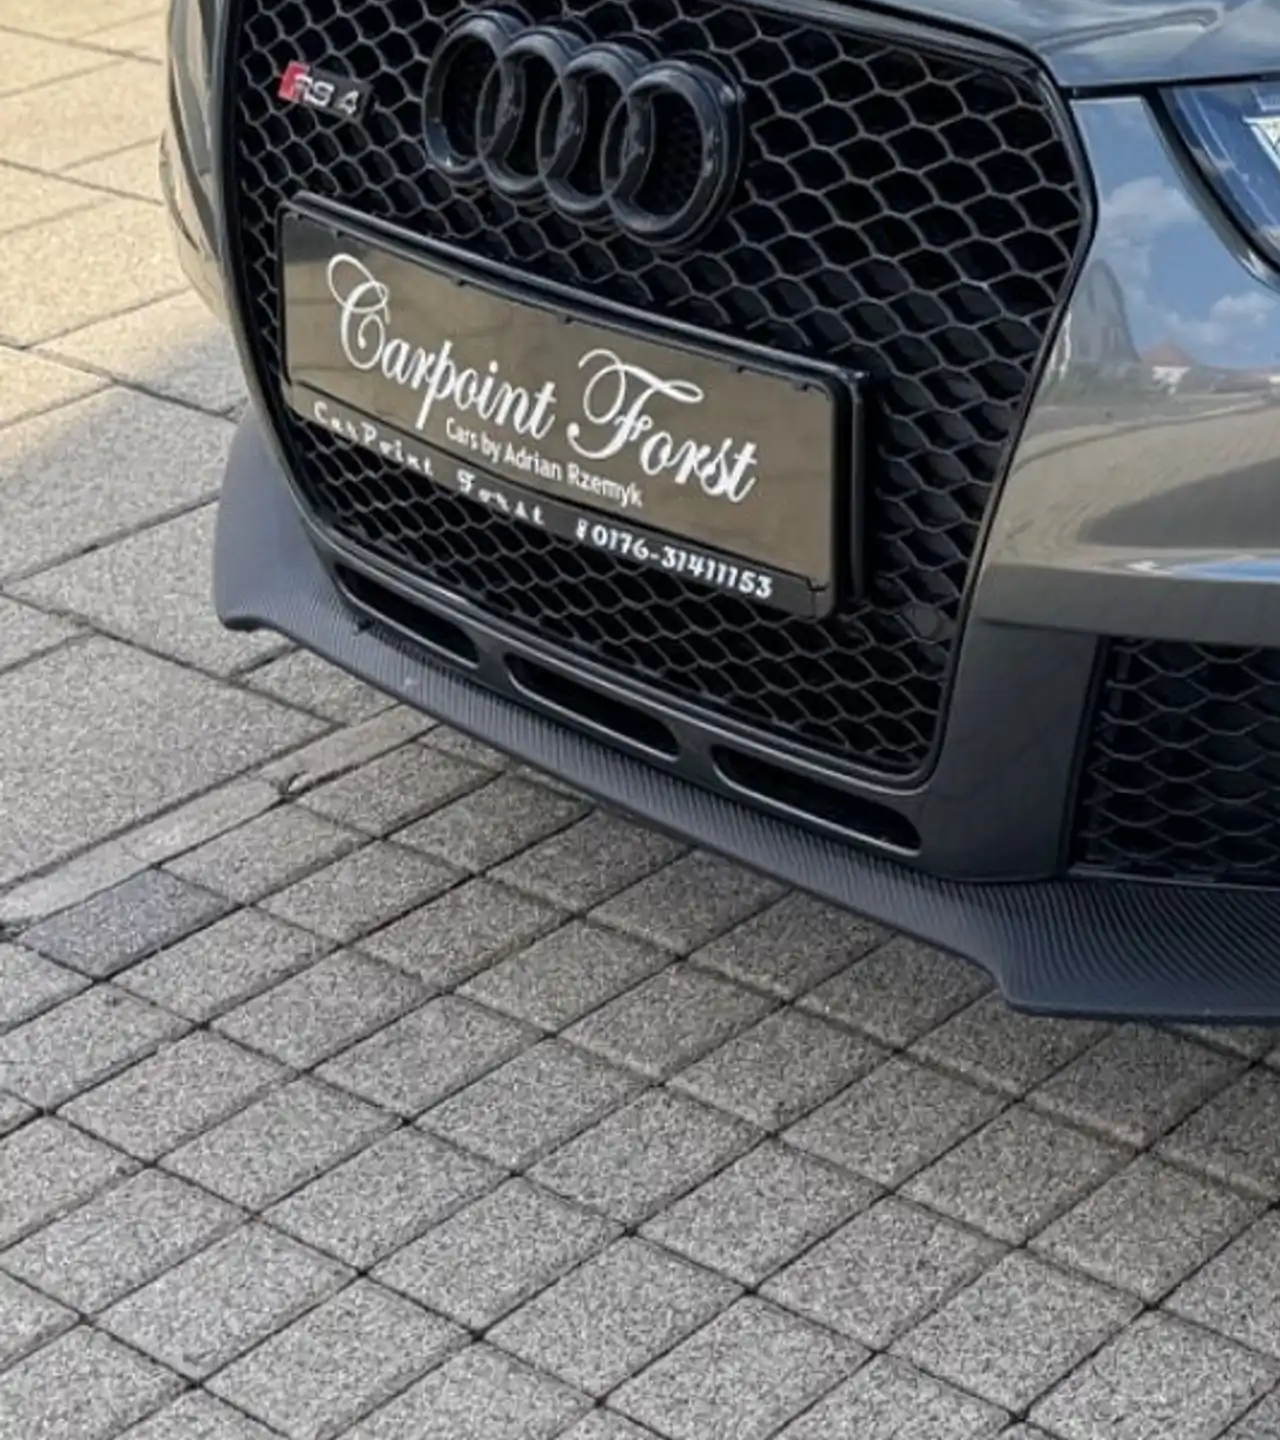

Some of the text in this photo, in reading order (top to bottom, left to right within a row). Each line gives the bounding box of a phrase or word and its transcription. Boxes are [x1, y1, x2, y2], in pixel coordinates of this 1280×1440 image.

[327, 254, 758, 504] Carpoint Forst
[446, 416, 478, 450] Cars
[480, 431, 501, 464] by
[504, 442, 563, 482] Adrian
[591, 524, 774, 600] 0176-31411153
